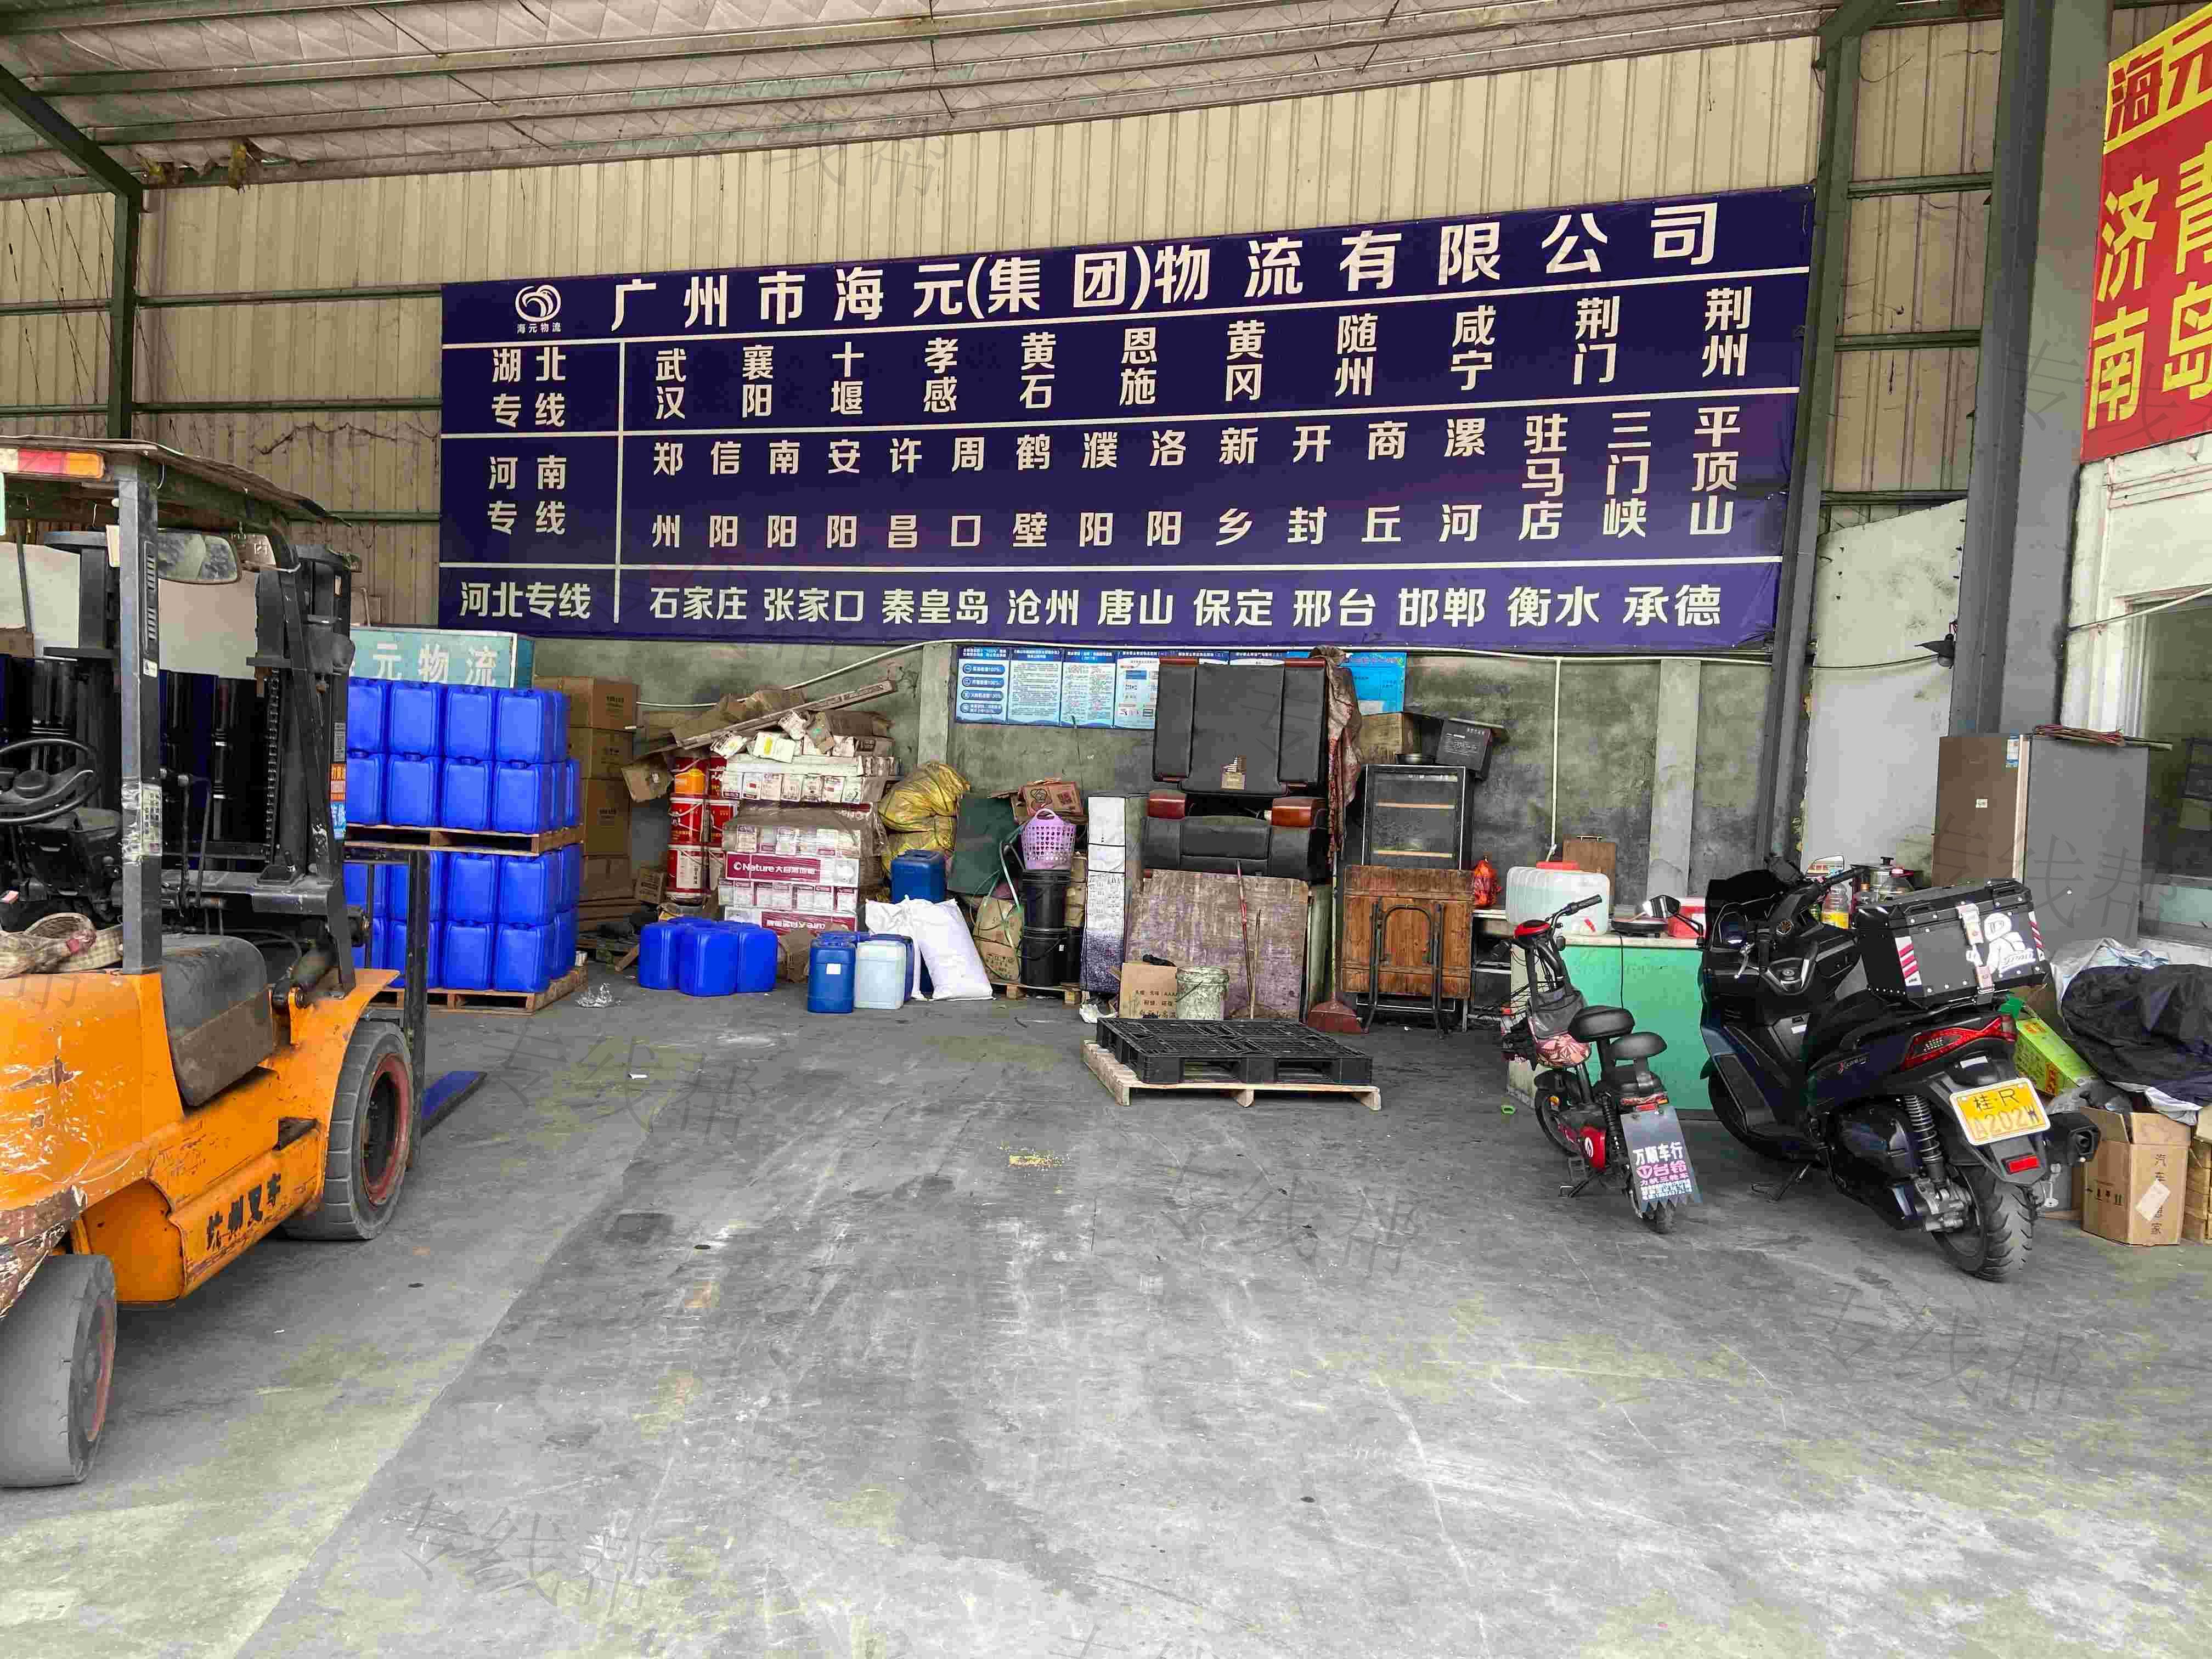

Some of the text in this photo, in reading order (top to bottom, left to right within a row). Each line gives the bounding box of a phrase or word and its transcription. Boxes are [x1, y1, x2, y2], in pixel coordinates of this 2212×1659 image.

[611, 204, 1718, 331] 广州市海元(集团)物流有限公司
[2087, 174, 2158, 430] 济南
[517, 322, 561, 334] 海元物流
[1226, 320, 1265, 401] 黄冈
[1335, 313, 1378, 397] 随州
[1451, 305, 1496, 390] 咸宁
[1573, 296, 1620, 385] 荆门
[1702, 286, 1751, 377] 荆州
[656, 348, 686, 419] 武汉
[743, 345, 774, 417] 襄阳
[831, 342, 864, 414] 十堰
[924, 337, 958, 413] 孝感
[1020, 332, 1056, 408] 黄石
[1120, 328, 1157, 405] 恩施
[1519, 414, 1568, 541] 驻马店
[1602, 411, 1651, 538] 三门峡
[1690, 407, 1740, 535] 平顶山
[460, 582, 590, 619] 河北专线
[650, 586, 747, 620] 石家庄
[764, 588, 864, 622] 张家口
[882, 589, 988, 624] 秦皇岛
[1006, 589, 1079, 625] 沧州
[1098, 589, 1173, 625] 唐山
[1194, 589, 1273, 626] 保定
[1293, 589, 1376, 627] 邢台
[1398, 588, 1486, 627] 邯郸
[1507, 586, 1600, 628] 衡水
[1623, 584, 1720, 626] 承德
[350, 642, 497, 686] 元物流
[742, 863, 774, 872] Nature
